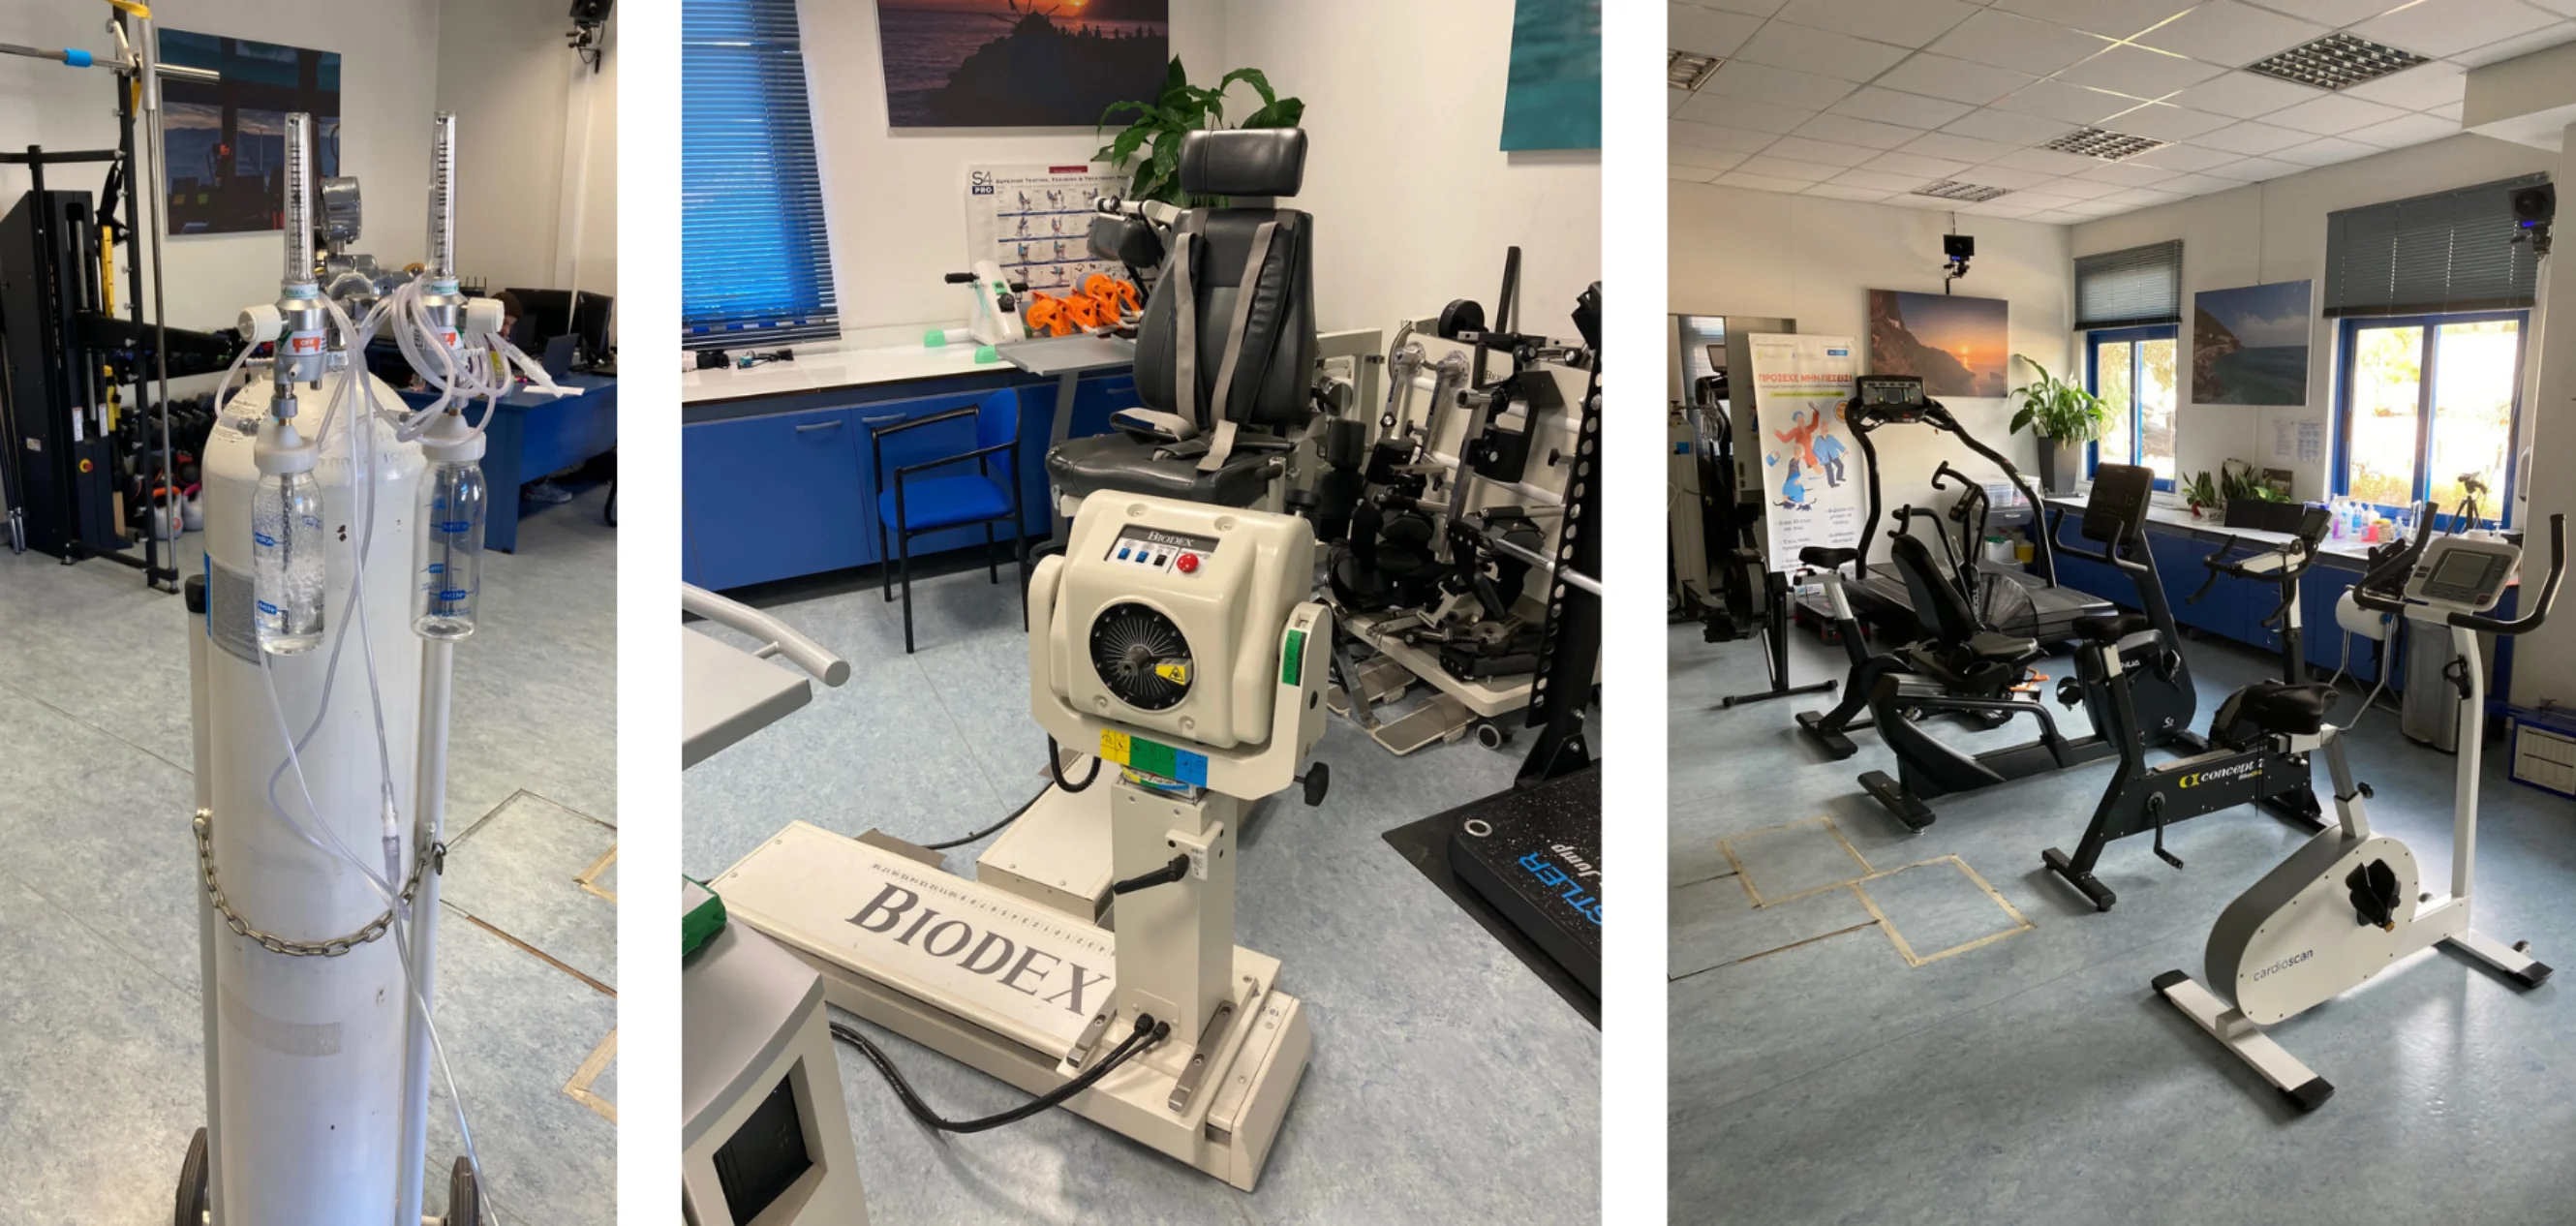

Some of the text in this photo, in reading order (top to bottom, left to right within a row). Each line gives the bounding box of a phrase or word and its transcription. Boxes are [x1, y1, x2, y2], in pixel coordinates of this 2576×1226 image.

[972, 170, 993, 186] S4
[1147, 530, 1195, 547] BIODEX
[2200, 760, 2255, 782] concept
[844, 882, 1110, 1016] BIODEX
[2253, 949, 2314, 981] cardioscan
